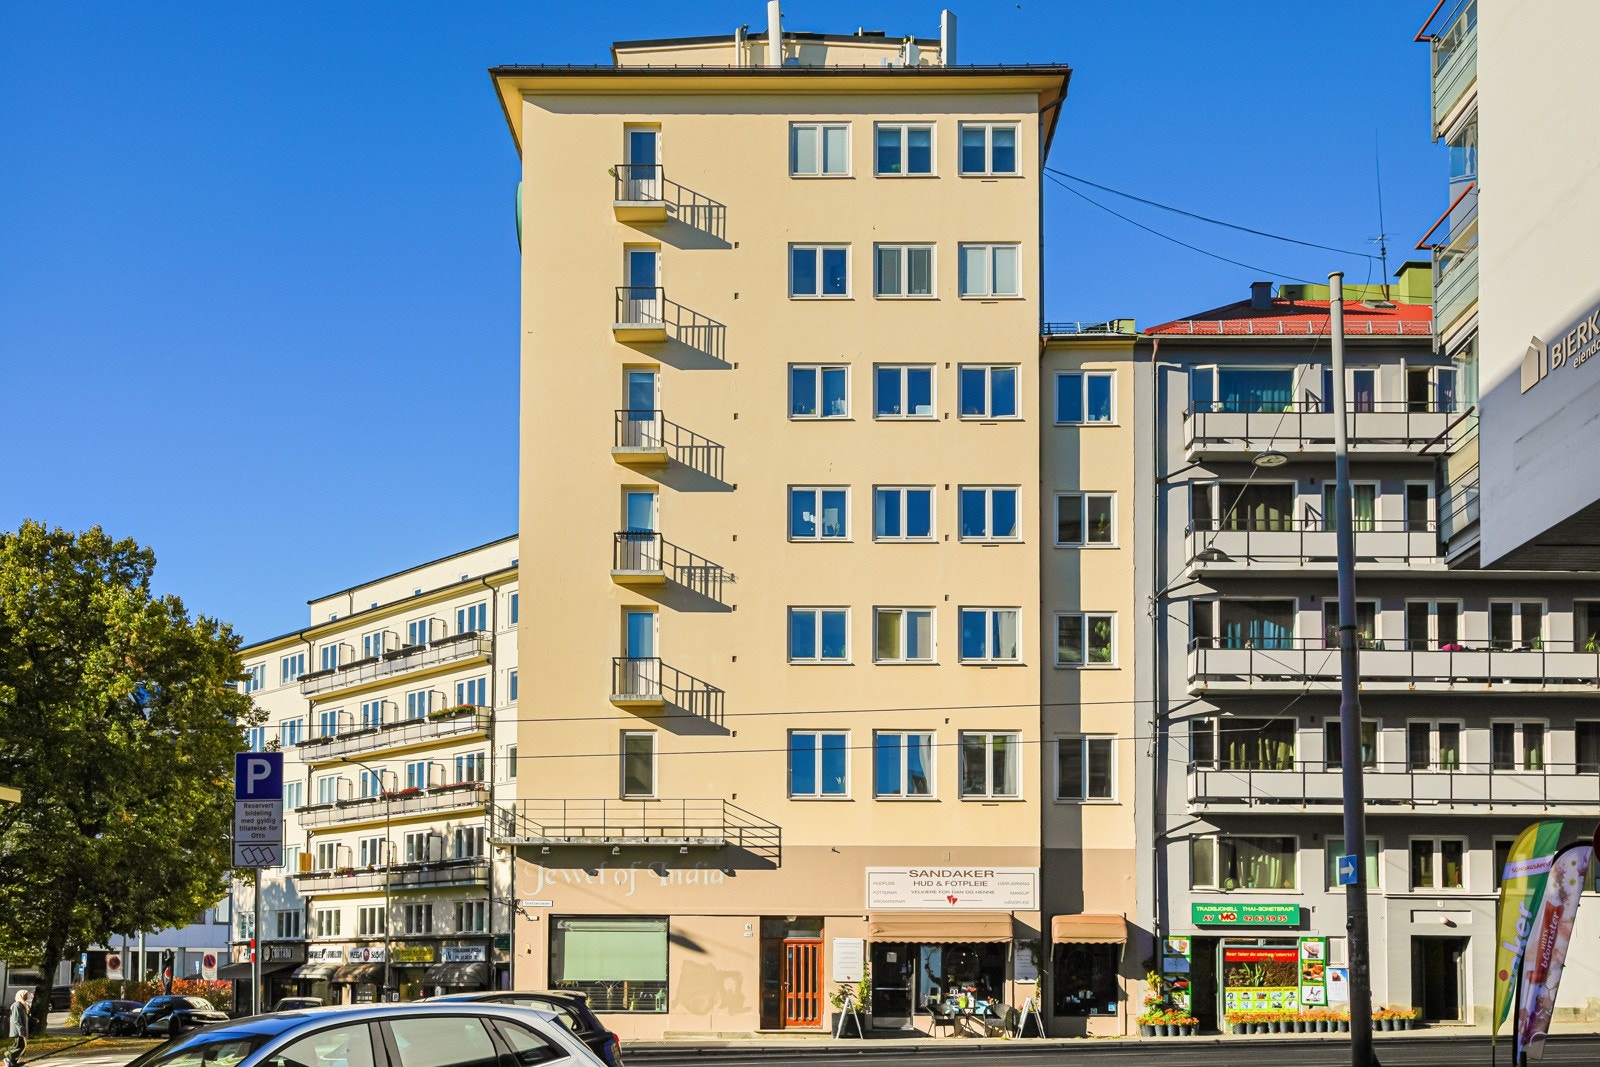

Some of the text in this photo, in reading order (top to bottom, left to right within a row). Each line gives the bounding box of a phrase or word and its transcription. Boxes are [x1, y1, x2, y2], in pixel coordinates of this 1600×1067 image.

[247, 759, 272, 794] P
[613, 861, 642, 896] of
[648, 861, 725, 887] India
[908, 869, 995, 878] SANDAKER
[1203, 914, 1215, 922] AV
[1542, 911, 1560, 969] blomster
